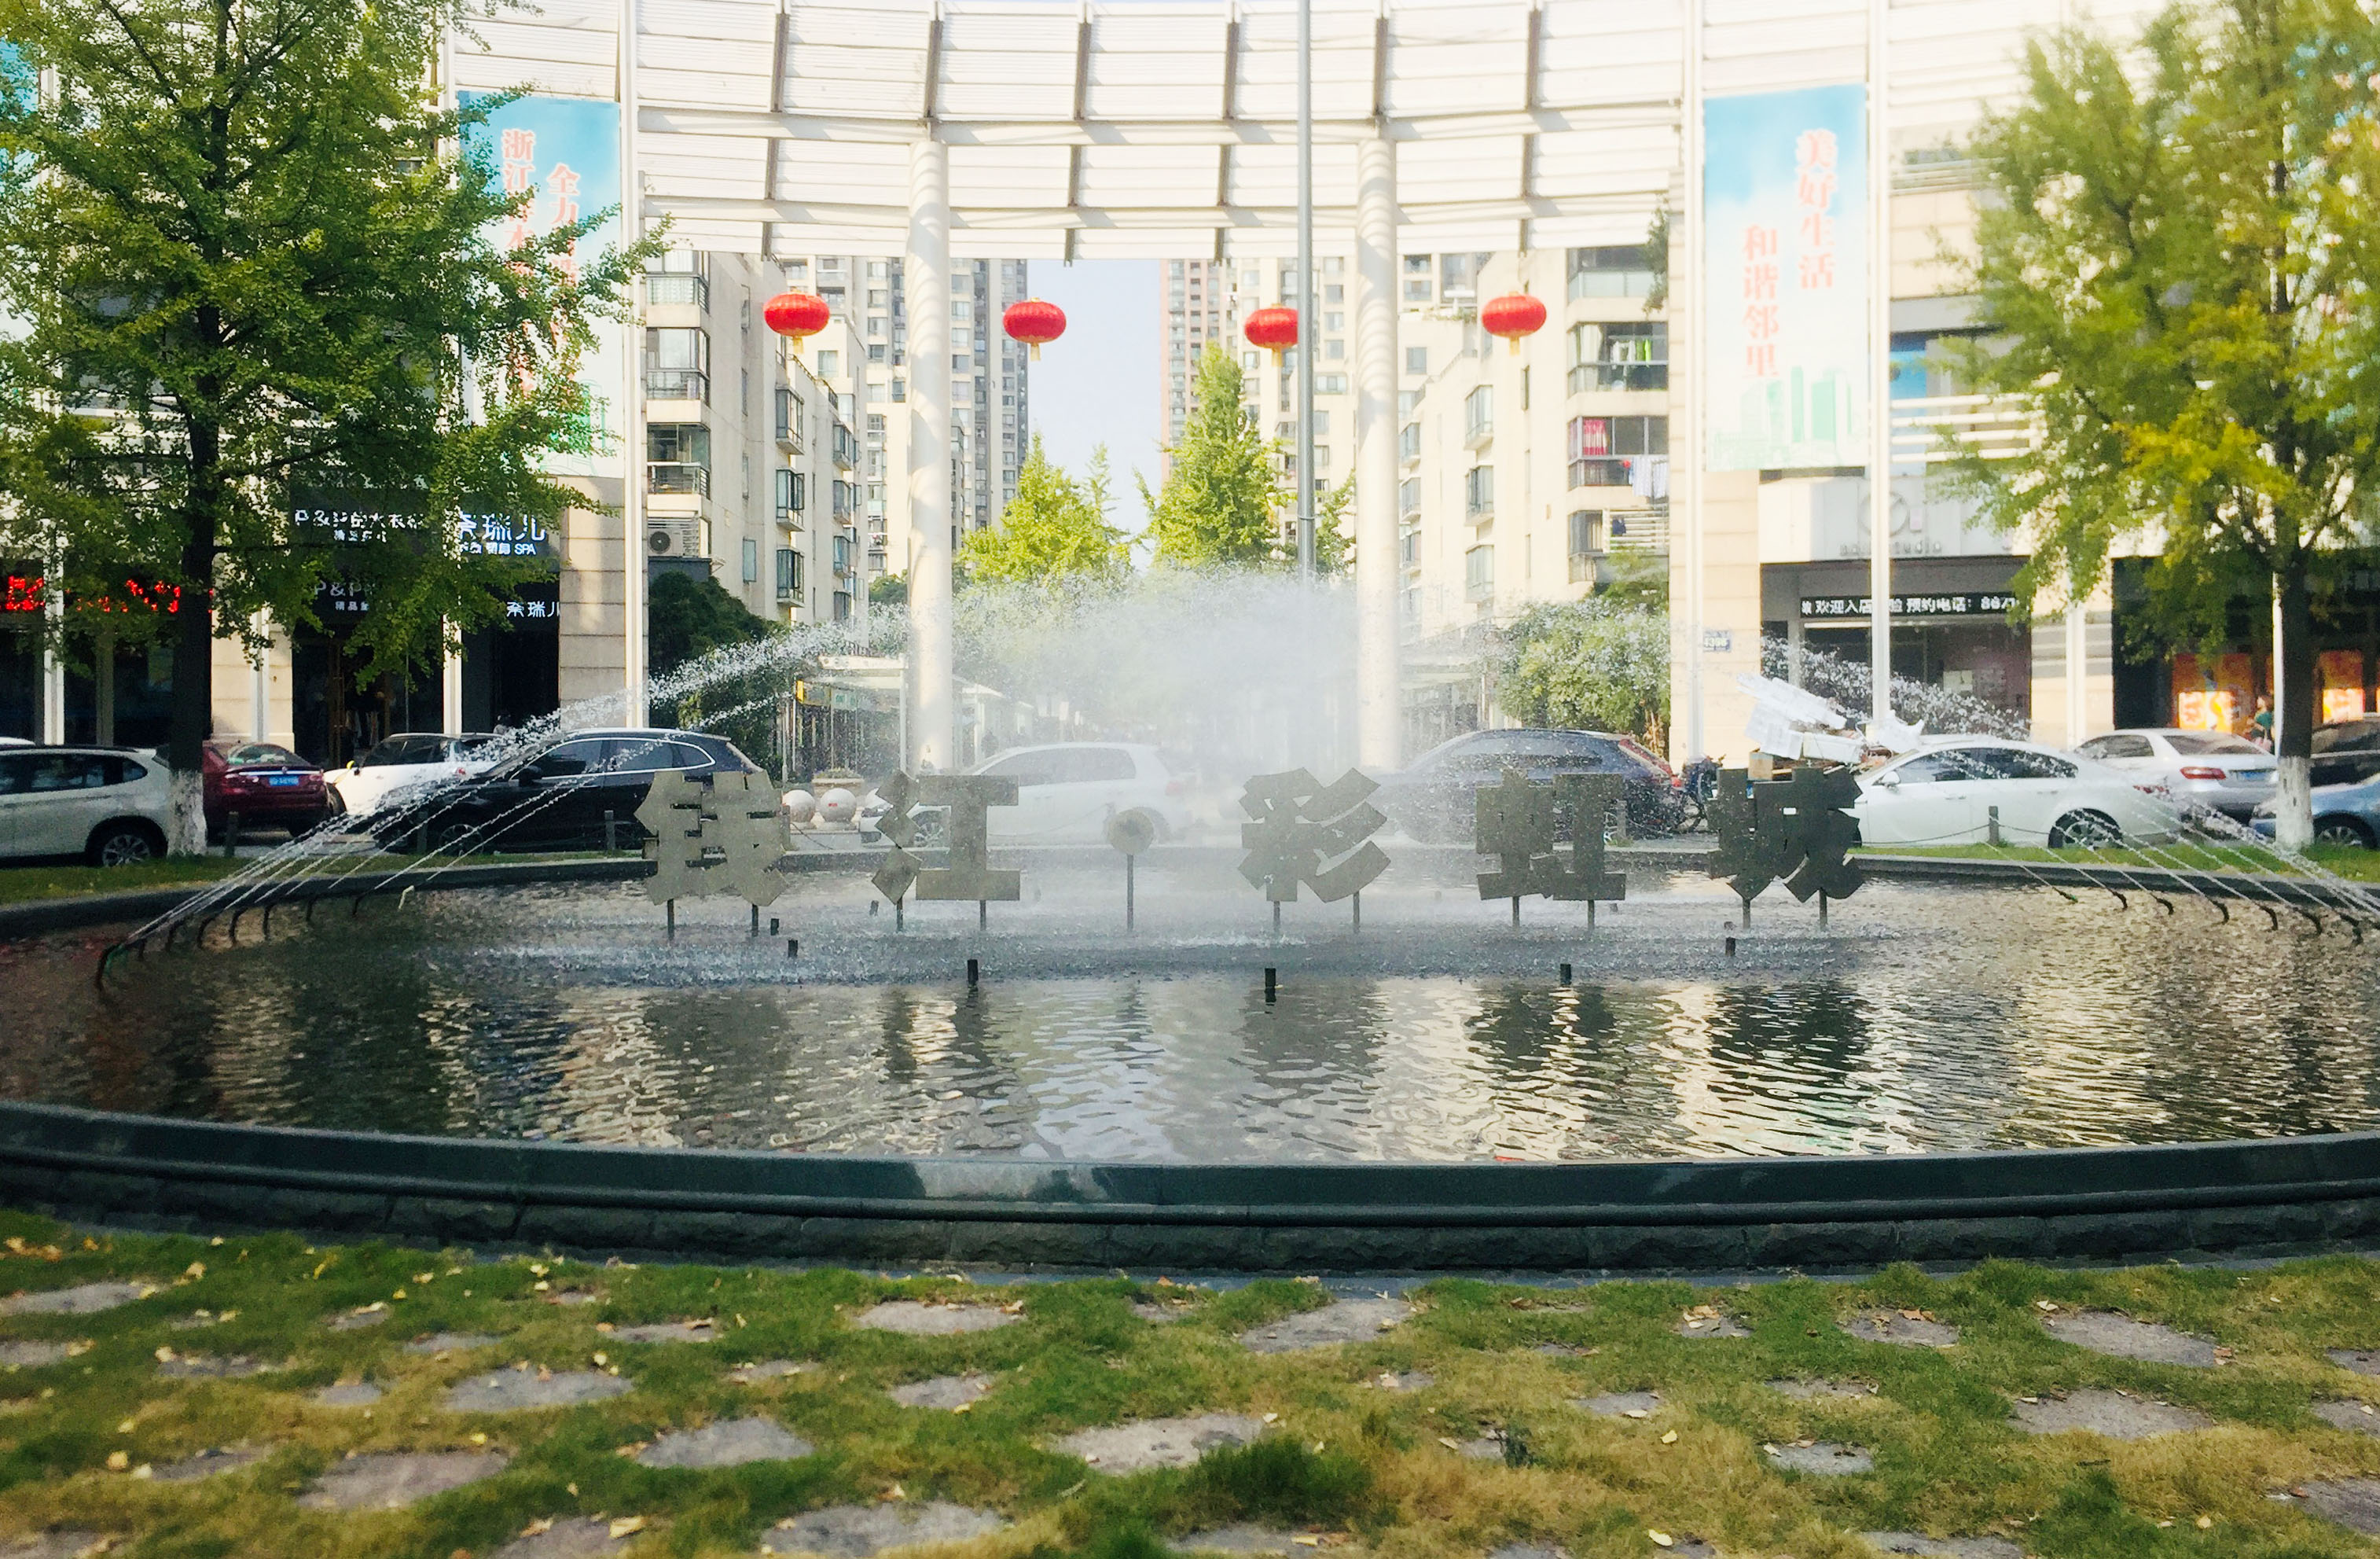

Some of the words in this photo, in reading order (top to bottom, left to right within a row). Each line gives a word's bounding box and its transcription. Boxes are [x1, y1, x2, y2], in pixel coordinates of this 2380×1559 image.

[1798, 131, 1835, 289] 美好生活
[1743, 225, 1779, 378] 和谐邻里
[514, 542, 537, 555] SPA
[1815, 597, 1902, 615] 欢迎入店验
